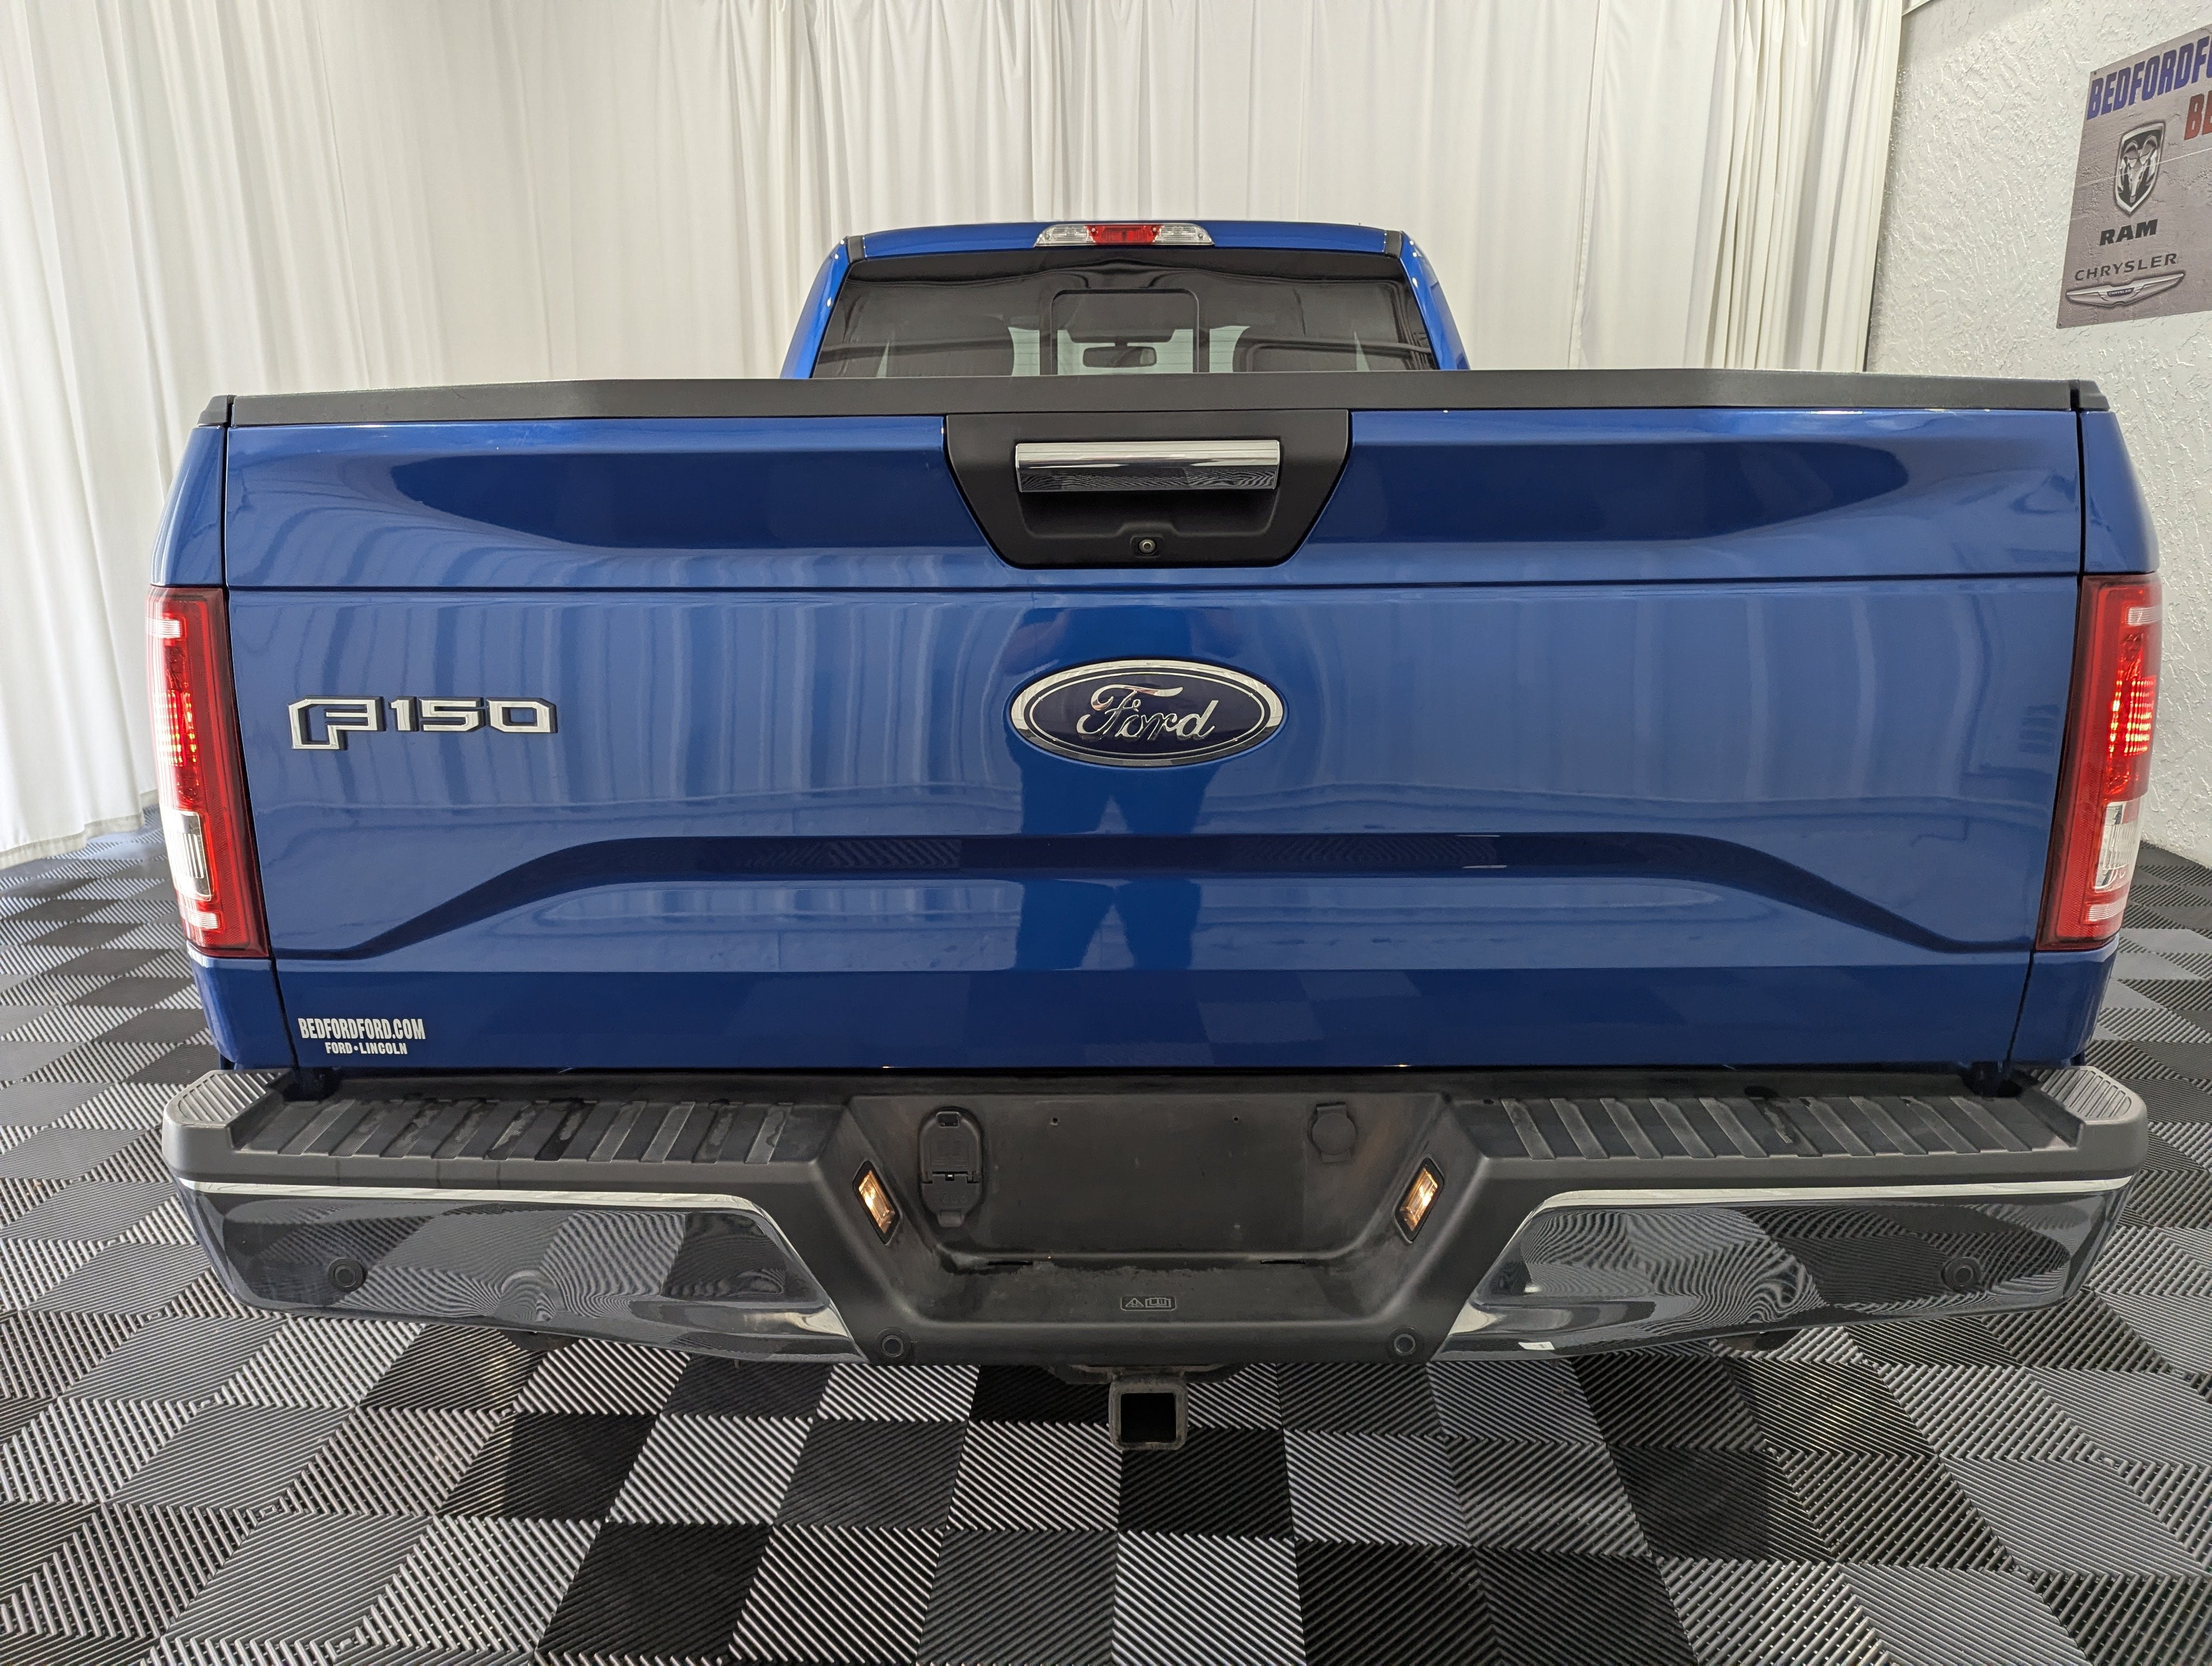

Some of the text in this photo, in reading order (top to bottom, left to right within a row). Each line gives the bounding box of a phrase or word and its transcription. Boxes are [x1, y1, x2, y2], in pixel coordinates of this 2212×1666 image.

[2087, 36, 2212, 120] BEDFORDF
[2099, 219, 2158, 246] RAM
[2074, 253, 2177, 280] CHRYSLER
[1076, 684, 1219, 740] Ford
[298, 1018, 426, 1039] BEDFORDFORD.COM
